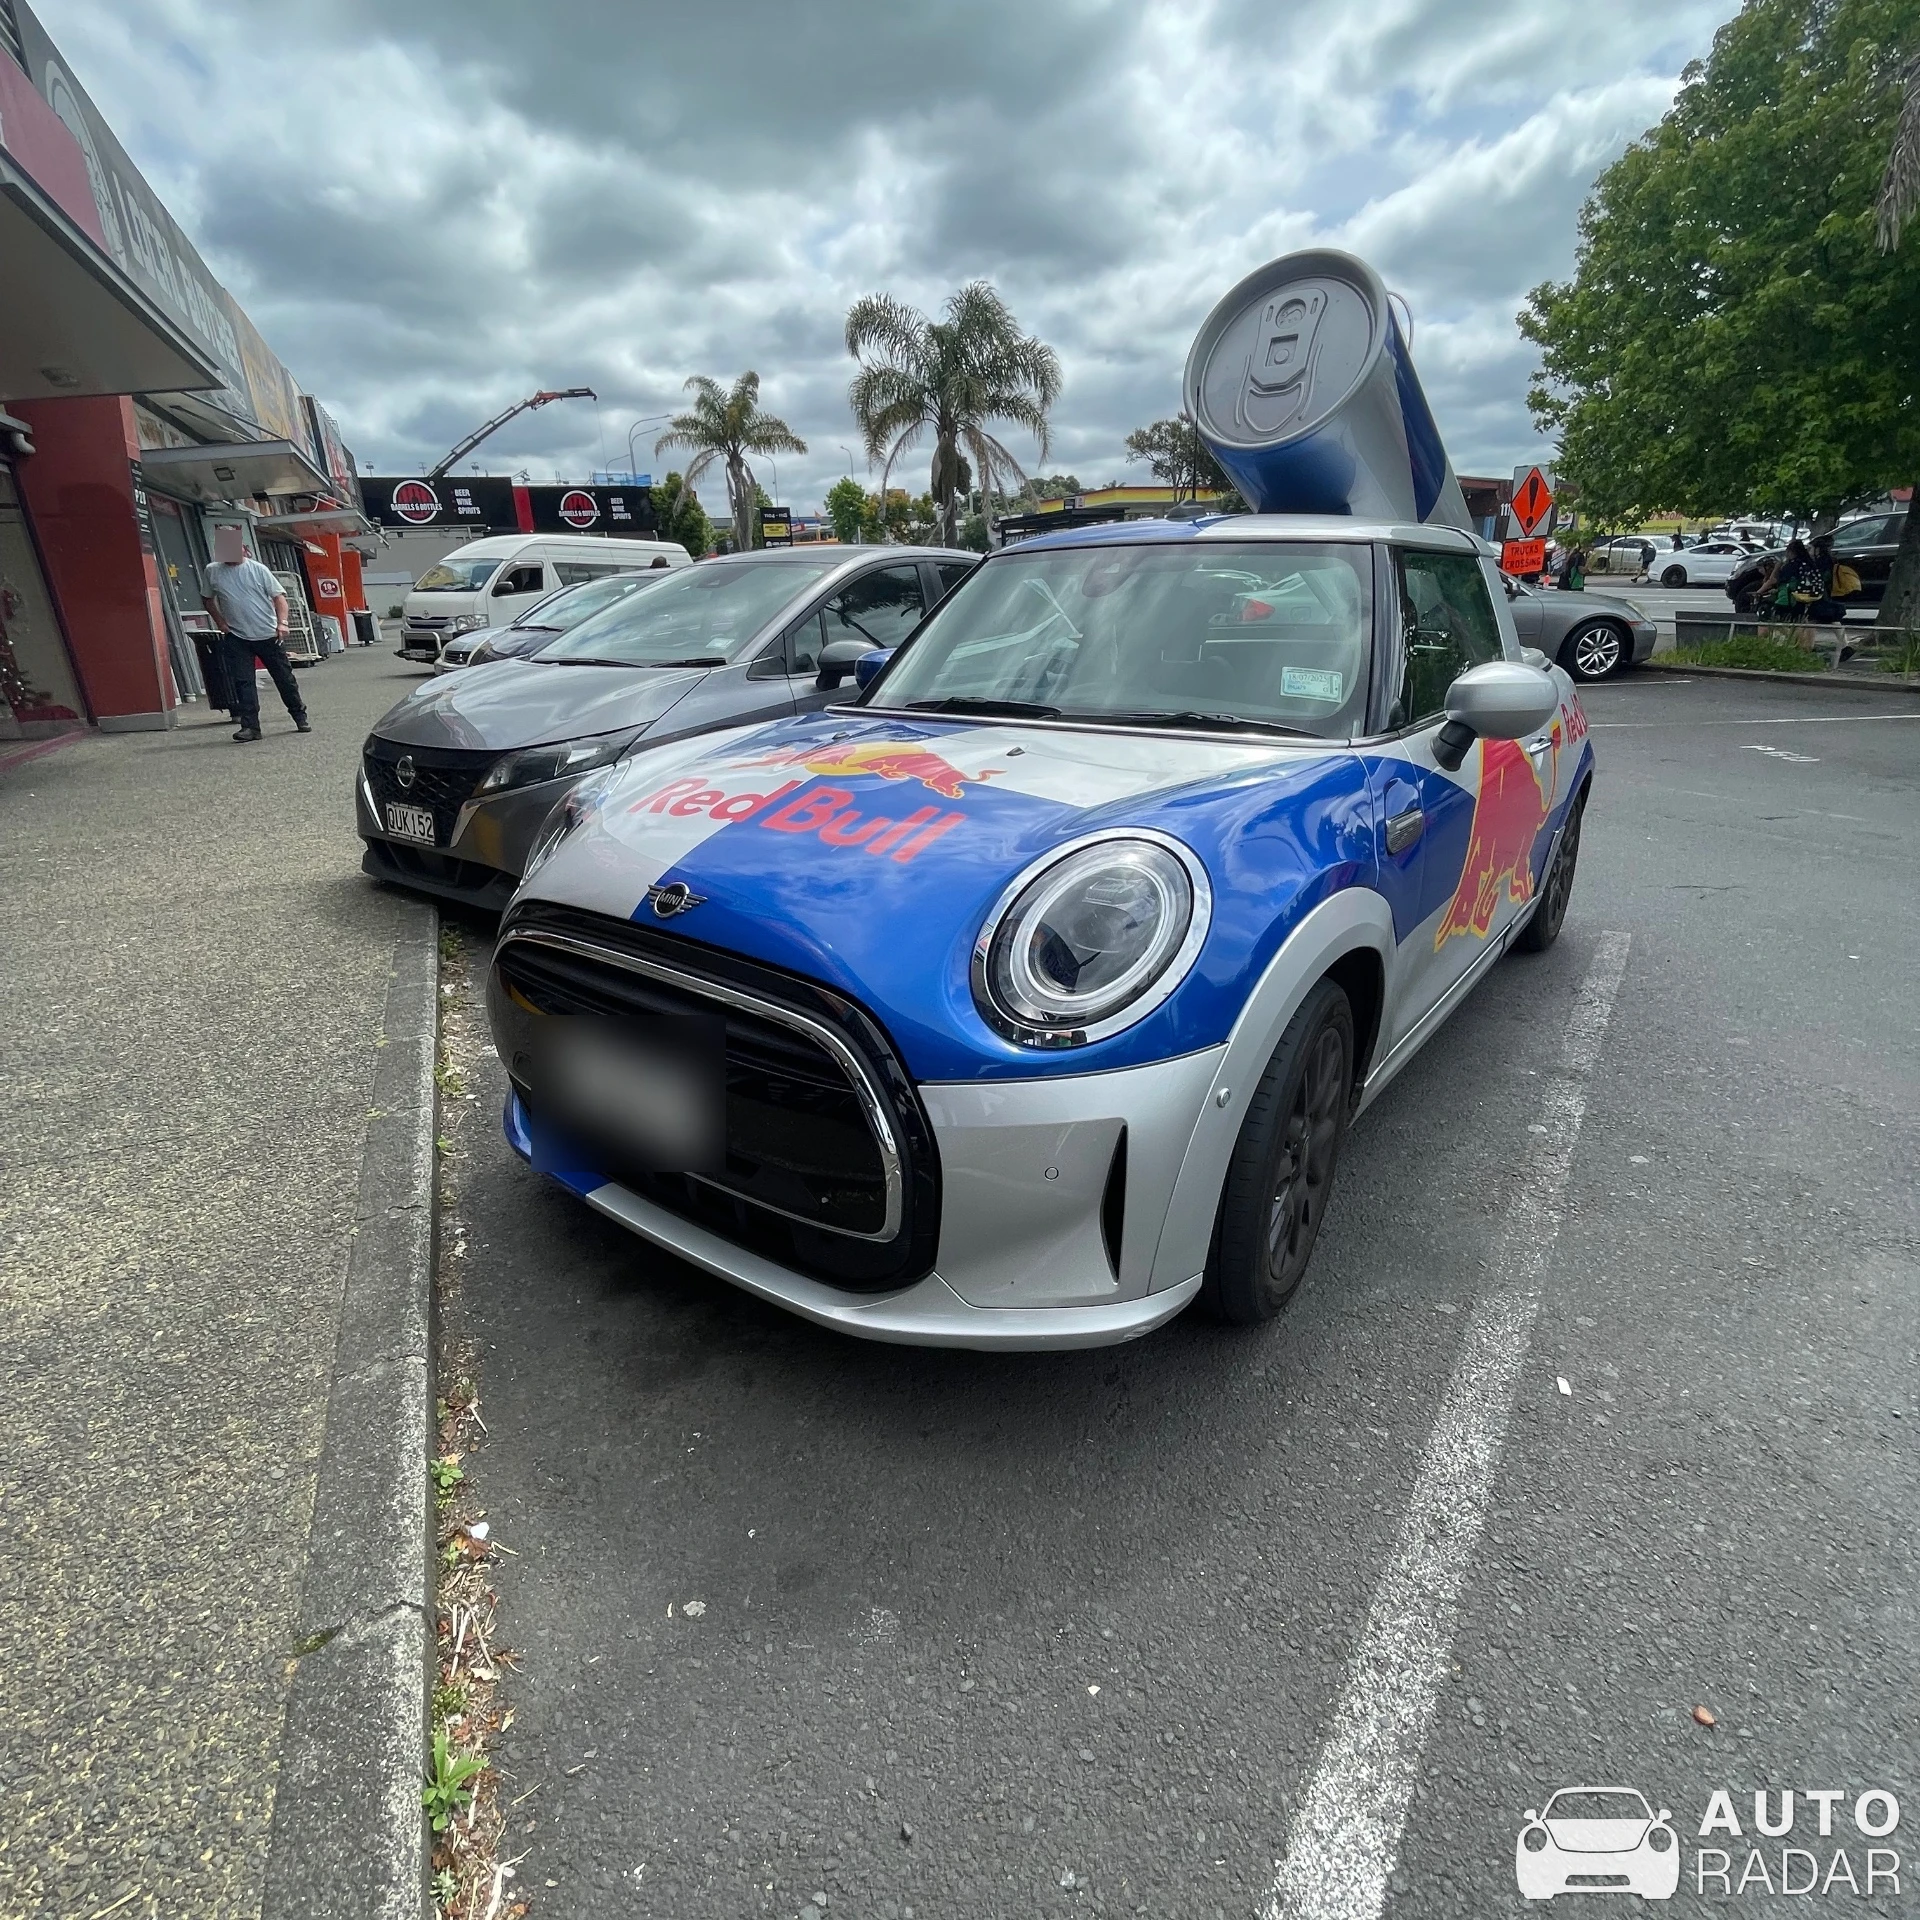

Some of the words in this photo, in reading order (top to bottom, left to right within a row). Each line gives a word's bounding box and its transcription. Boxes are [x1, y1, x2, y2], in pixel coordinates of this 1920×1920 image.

[112, 170, 189, 317] LOCAL
[454, 488, 470, 497] BEER
[390, 503, 414, 511] BARRELS
[415, 503, 419, 511] &
[420, 503, 443, 511] BOTTLES
[456, 498, 473, 506] WINE
[458, 507, 481, 515] SPIRITS
[612, 512, 632, 520] SPIRITS
[1511, 544, 1539, 556] TRUCKS
[1505, 557, 1540, 570] CROSSING
[388, 807, 434, 839] QUK152
[626, 778, 804, 823] Red
[759, 786, 968, 864] Bull
[658, 892, 682, 906] MINI
